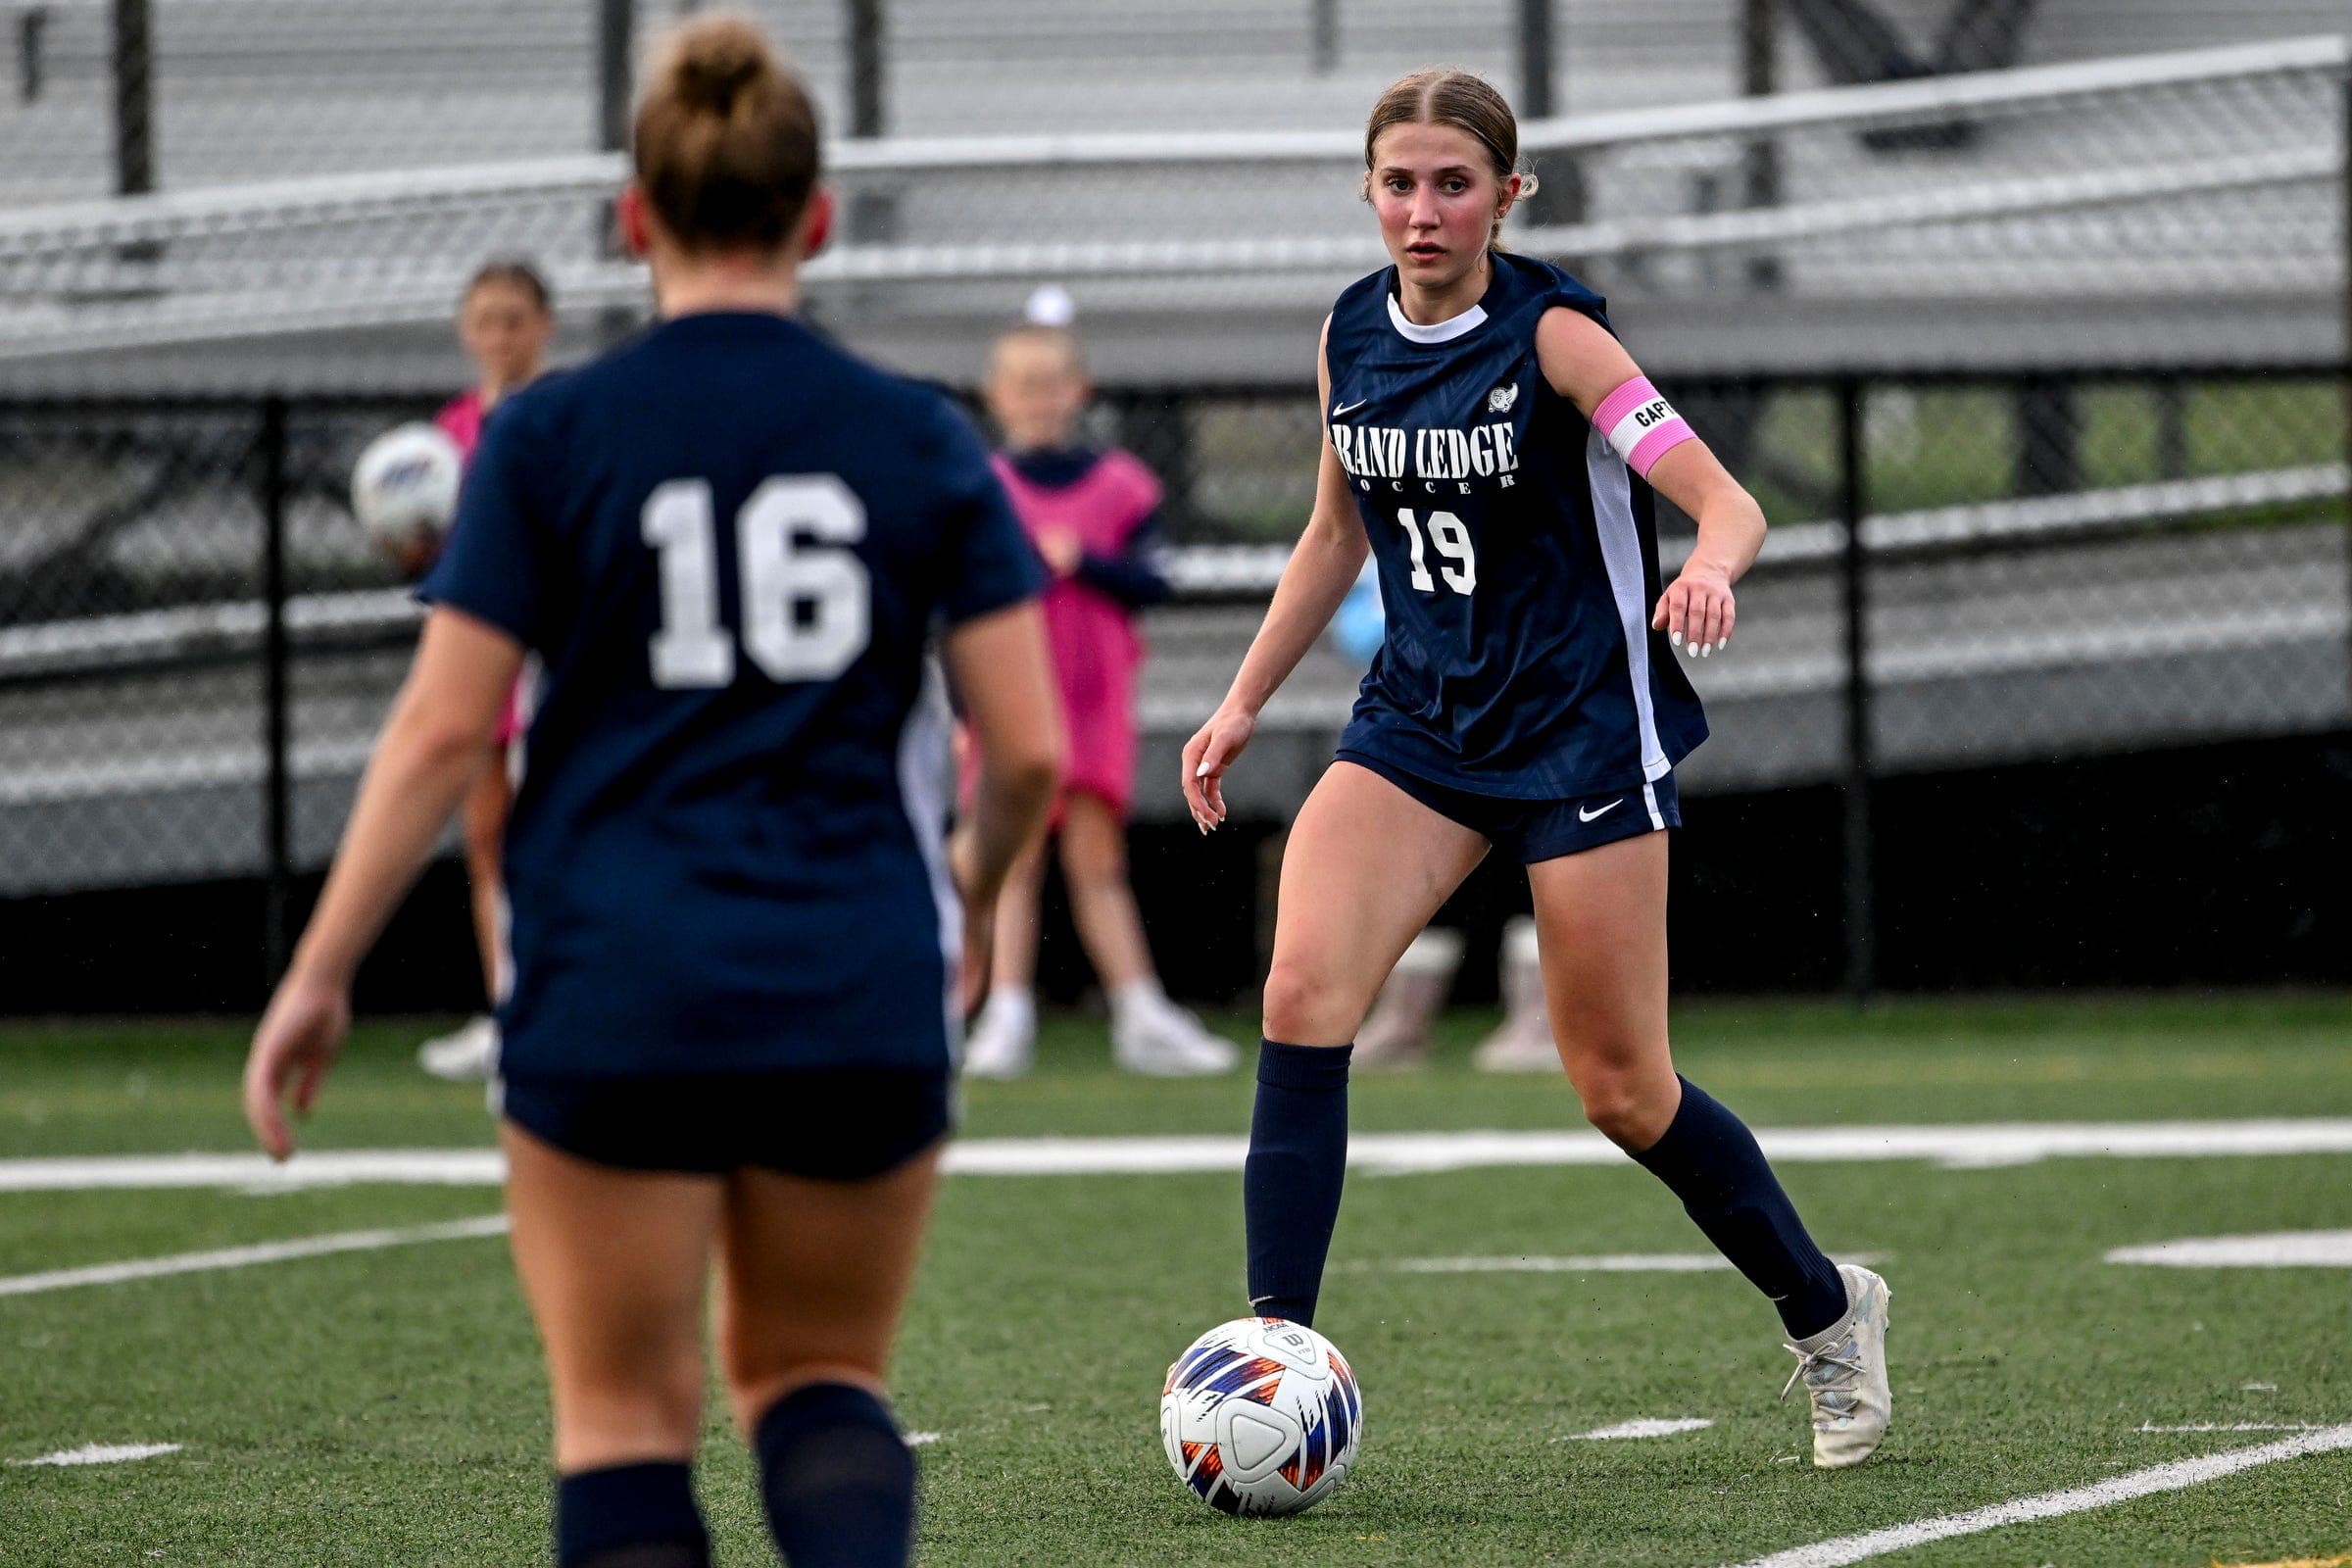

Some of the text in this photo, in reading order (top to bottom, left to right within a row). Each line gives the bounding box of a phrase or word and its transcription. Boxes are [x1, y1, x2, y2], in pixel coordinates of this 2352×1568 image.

[1328, 421, 1519, 479] RAND LEDGE
[1347, 472, 1516, 495] OCCER
[640, 471, 872, 689] 16
[1397, 508, 1477, 596] 19
